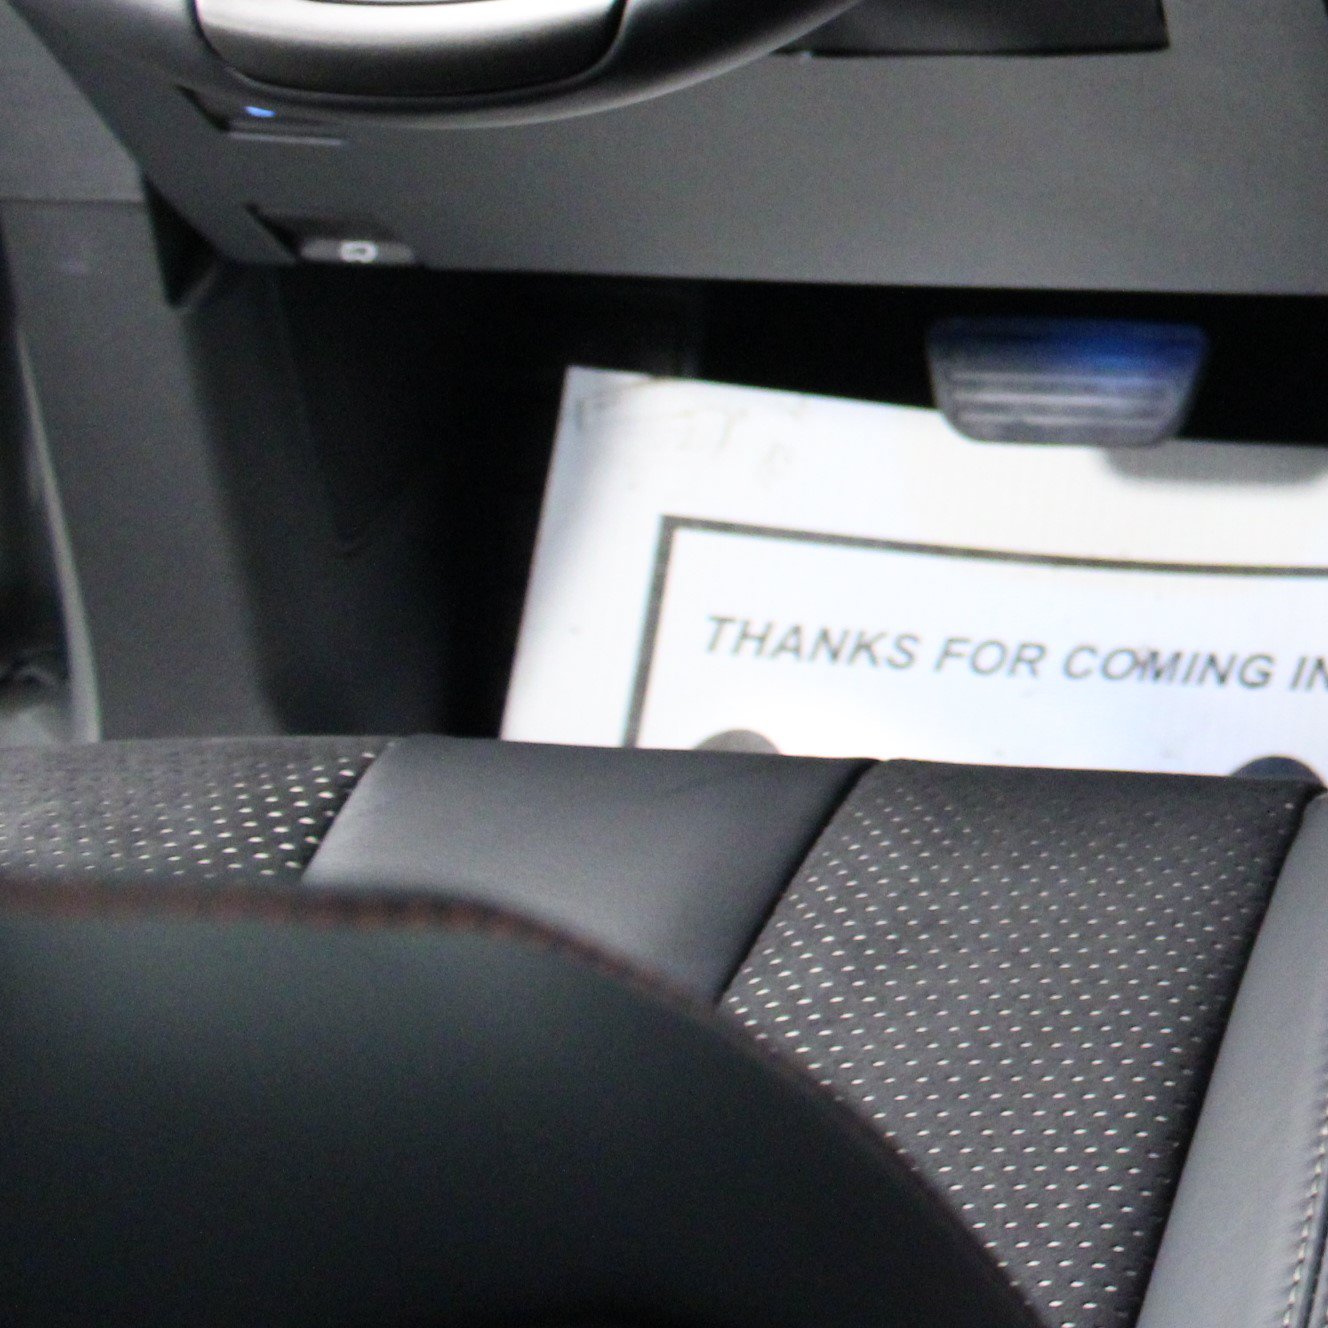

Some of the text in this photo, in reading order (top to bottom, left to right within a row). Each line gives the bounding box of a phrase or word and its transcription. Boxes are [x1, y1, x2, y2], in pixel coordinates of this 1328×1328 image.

[706, 615, 922, 670] THANKS
[934, 637, 1047, 678] FOR
[1062, 644, 1276, 690] COMING
